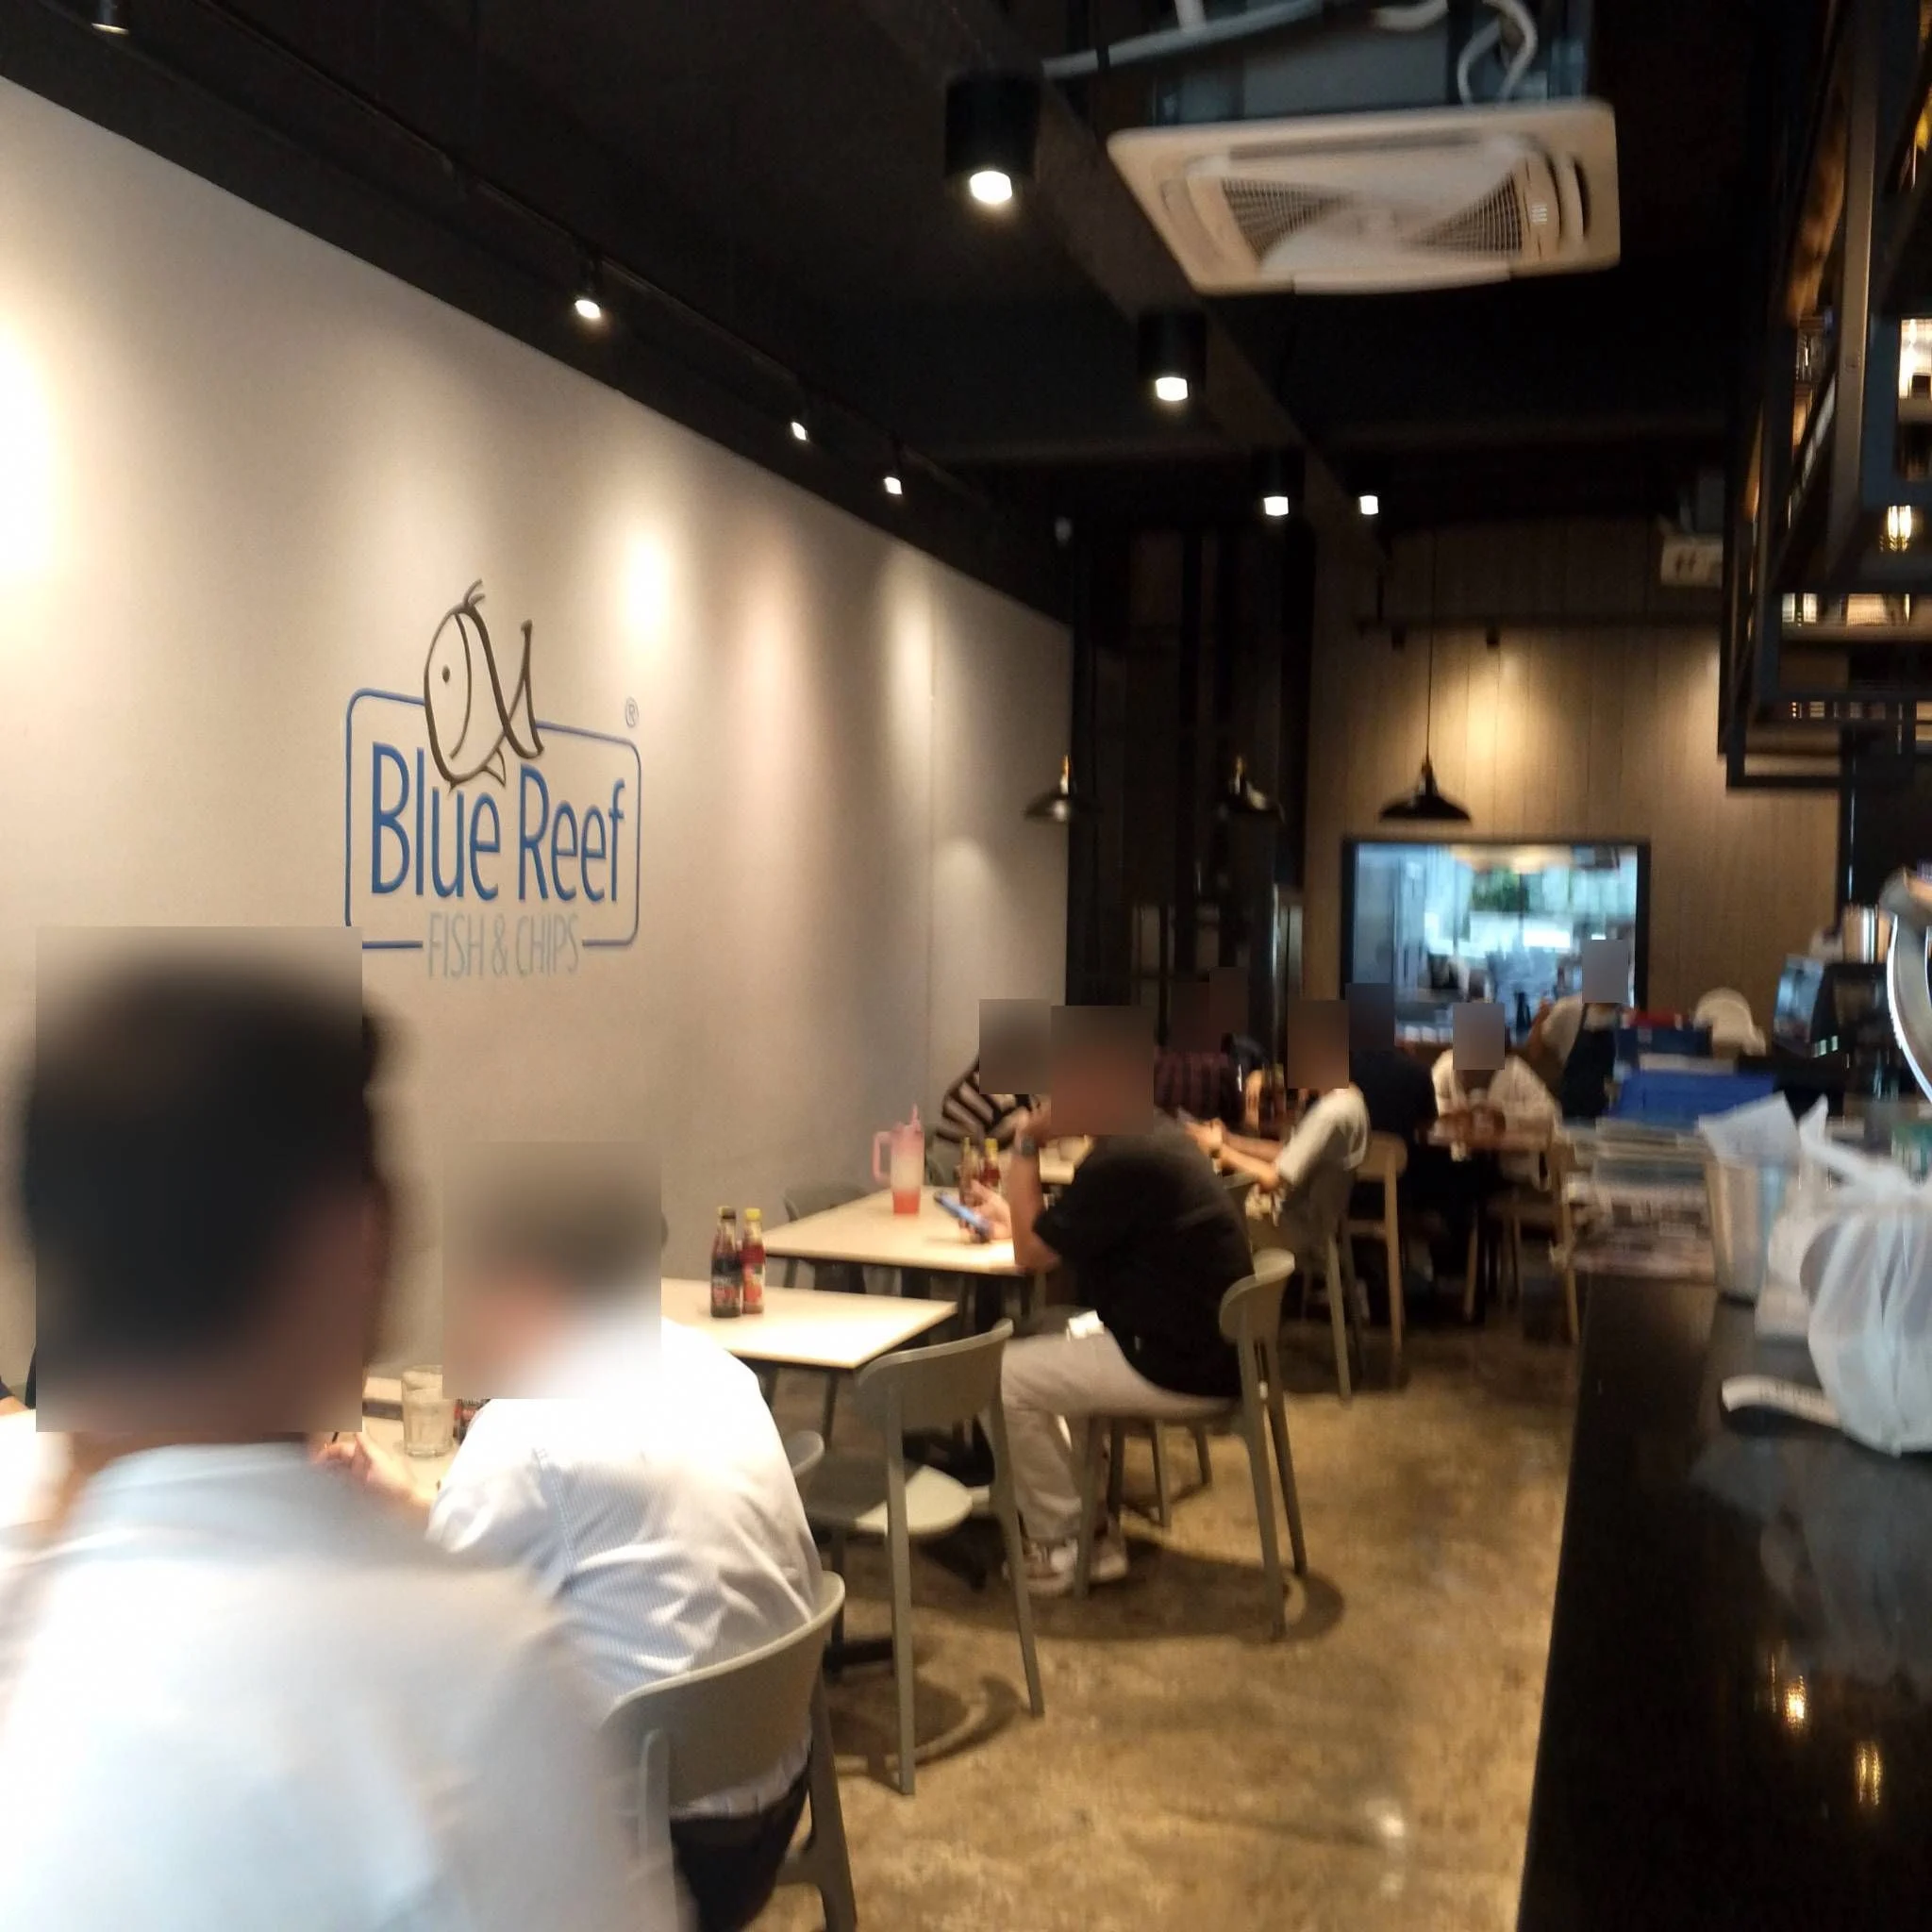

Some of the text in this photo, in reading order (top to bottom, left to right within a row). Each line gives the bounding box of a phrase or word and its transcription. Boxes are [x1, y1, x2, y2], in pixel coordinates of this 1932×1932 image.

[372, 741, 625, 902] Blue Reef
[427, 912, 580, 978] FISH & CHIPS
